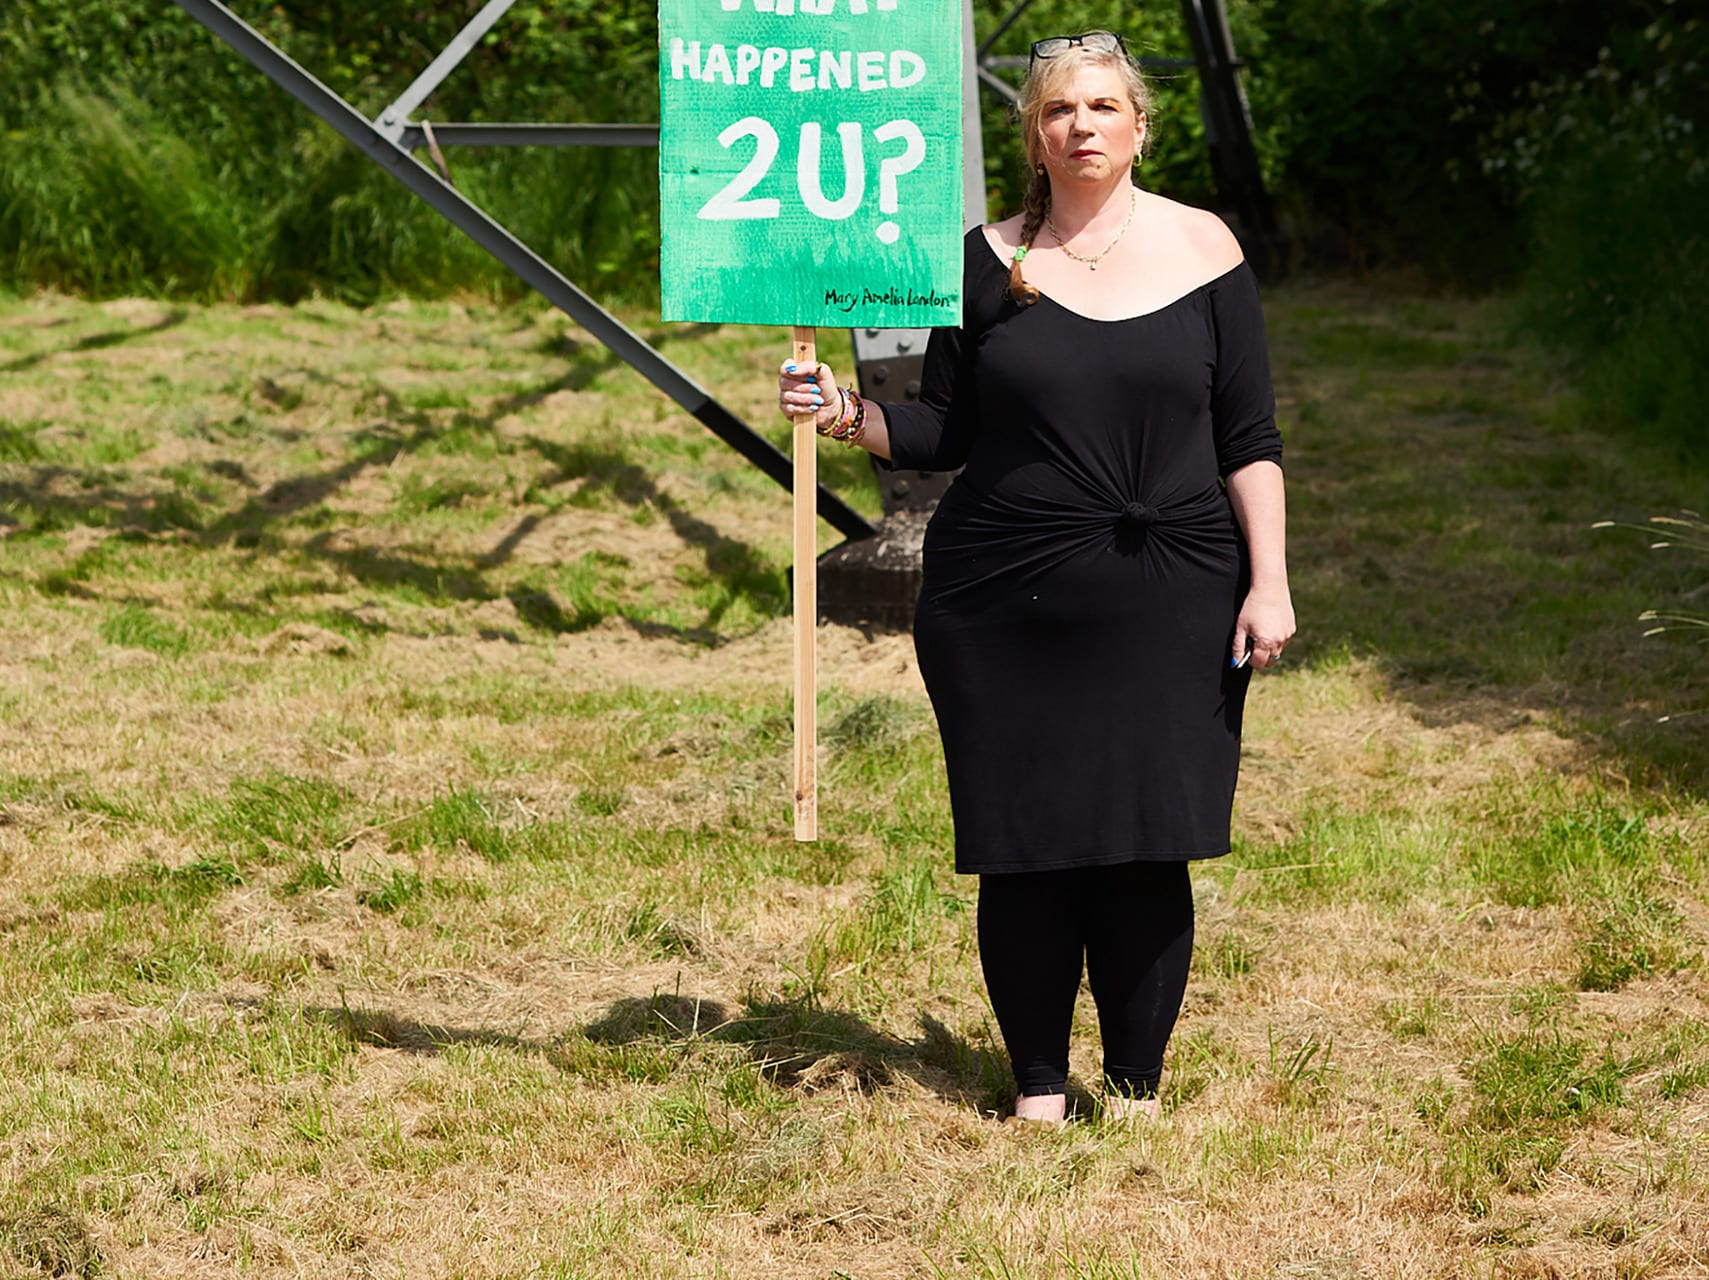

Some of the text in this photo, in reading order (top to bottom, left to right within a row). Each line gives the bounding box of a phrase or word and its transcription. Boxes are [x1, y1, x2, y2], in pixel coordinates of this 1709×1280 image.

[670, 37, 926, 92] HAPPENED
[825, 288, 858, 313] Mary
[862, 286, 904, 307] Amelia
